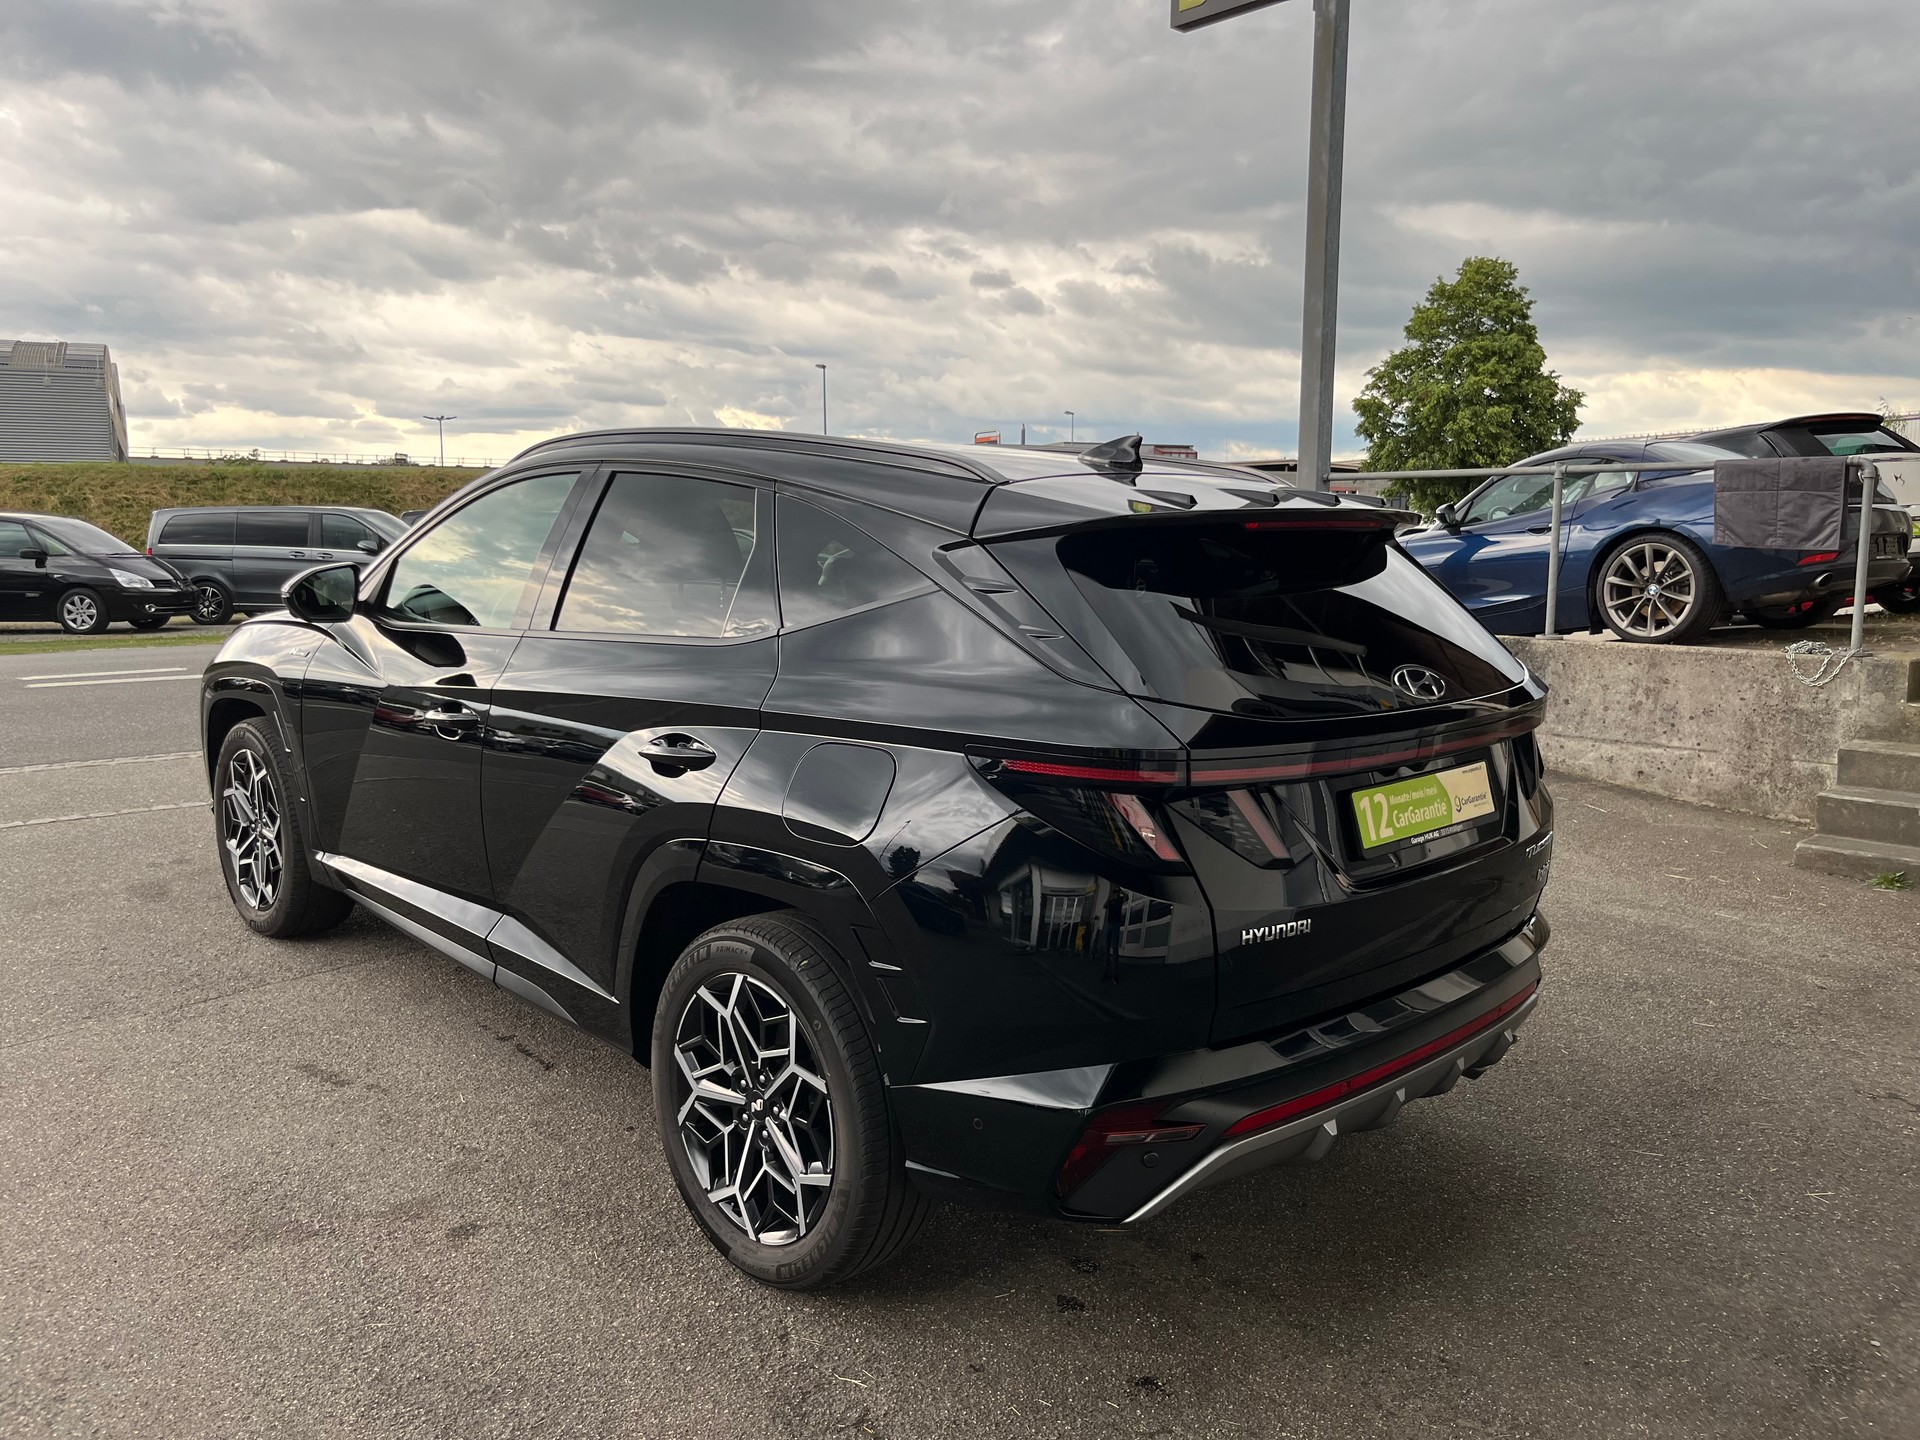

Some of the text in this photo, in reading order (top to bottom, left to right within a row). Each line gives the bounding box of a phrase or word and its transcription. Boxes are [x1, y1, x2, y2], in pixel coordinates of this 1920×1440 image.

[1359, 793, 1394, 842] 12
[716, 945, 745, 954] PRIMACY
[1241, 918, 1312, 946] HYUNDAI
[657, 945, 709, 1016] MICHELIN
[779, 1218, 841, 1280] MICHELIN
